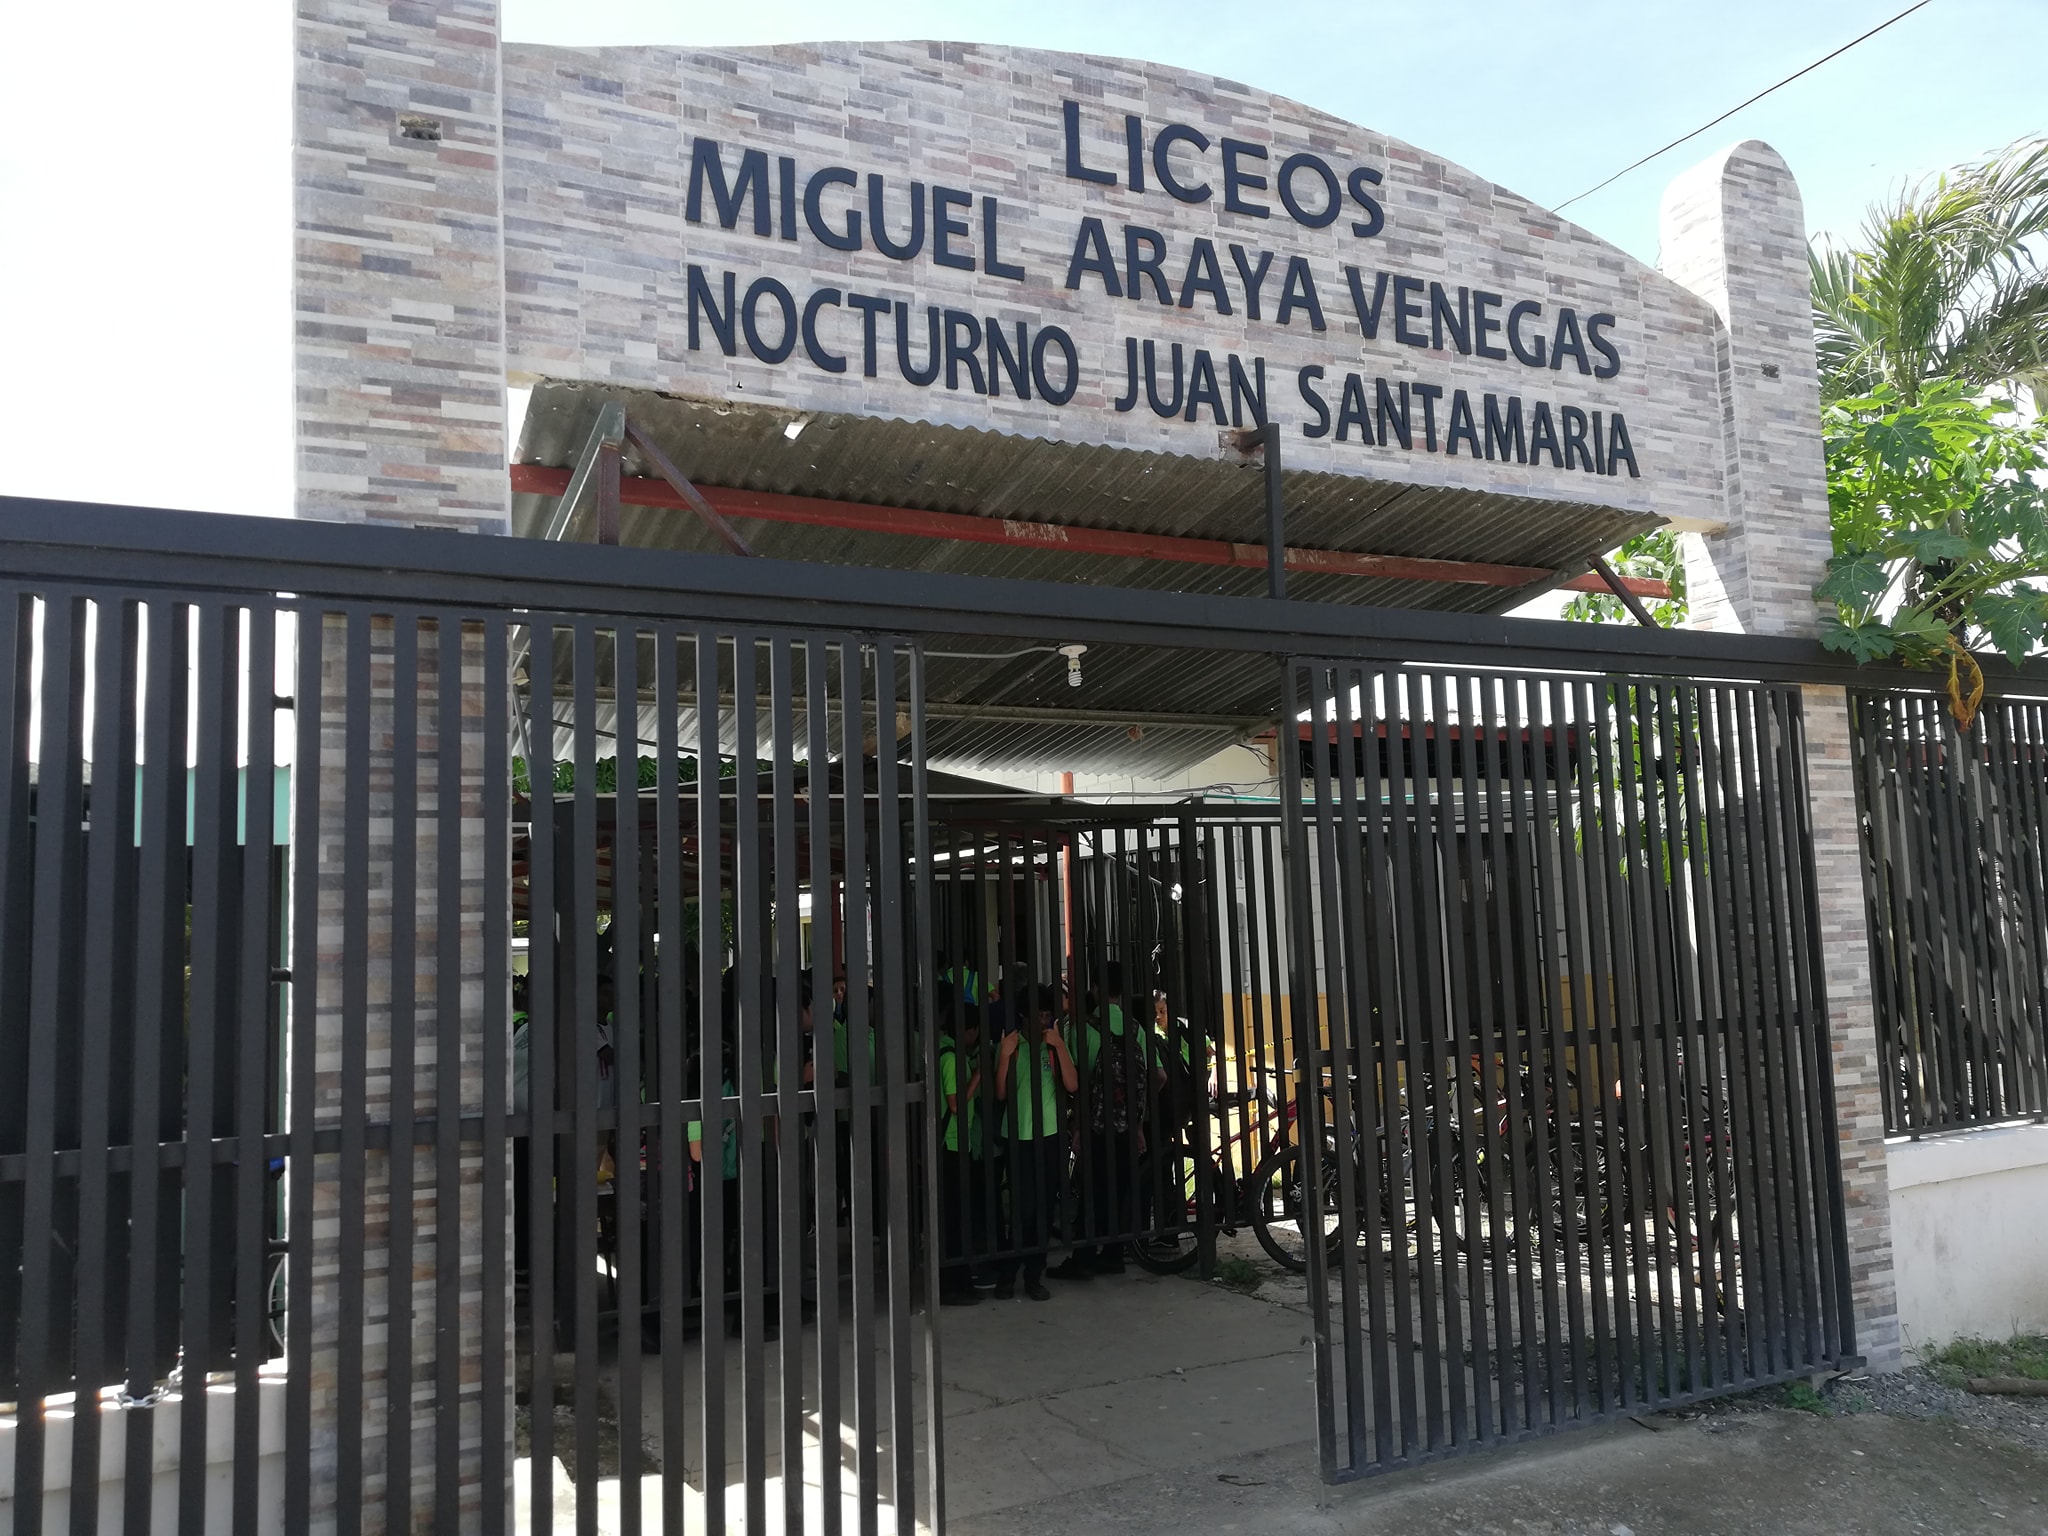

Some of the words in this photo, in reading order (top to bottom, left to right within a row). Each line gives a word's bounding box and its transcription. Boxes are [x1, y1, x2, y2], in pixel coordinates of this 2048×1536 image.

[685, 137, 1026, 283] MIGUEL
[1064, 216, 1328, 333] ARAYA
[1344, 265, 1622, 381] VENEGAS
[1063, 99, 1385, 239] LICEOS
[687, 264, 1080, 408] NOCTURNO
[1114, 337, 1269, 430] JUAN
[1298, 365, 1641, 479] SANTAMARIA
